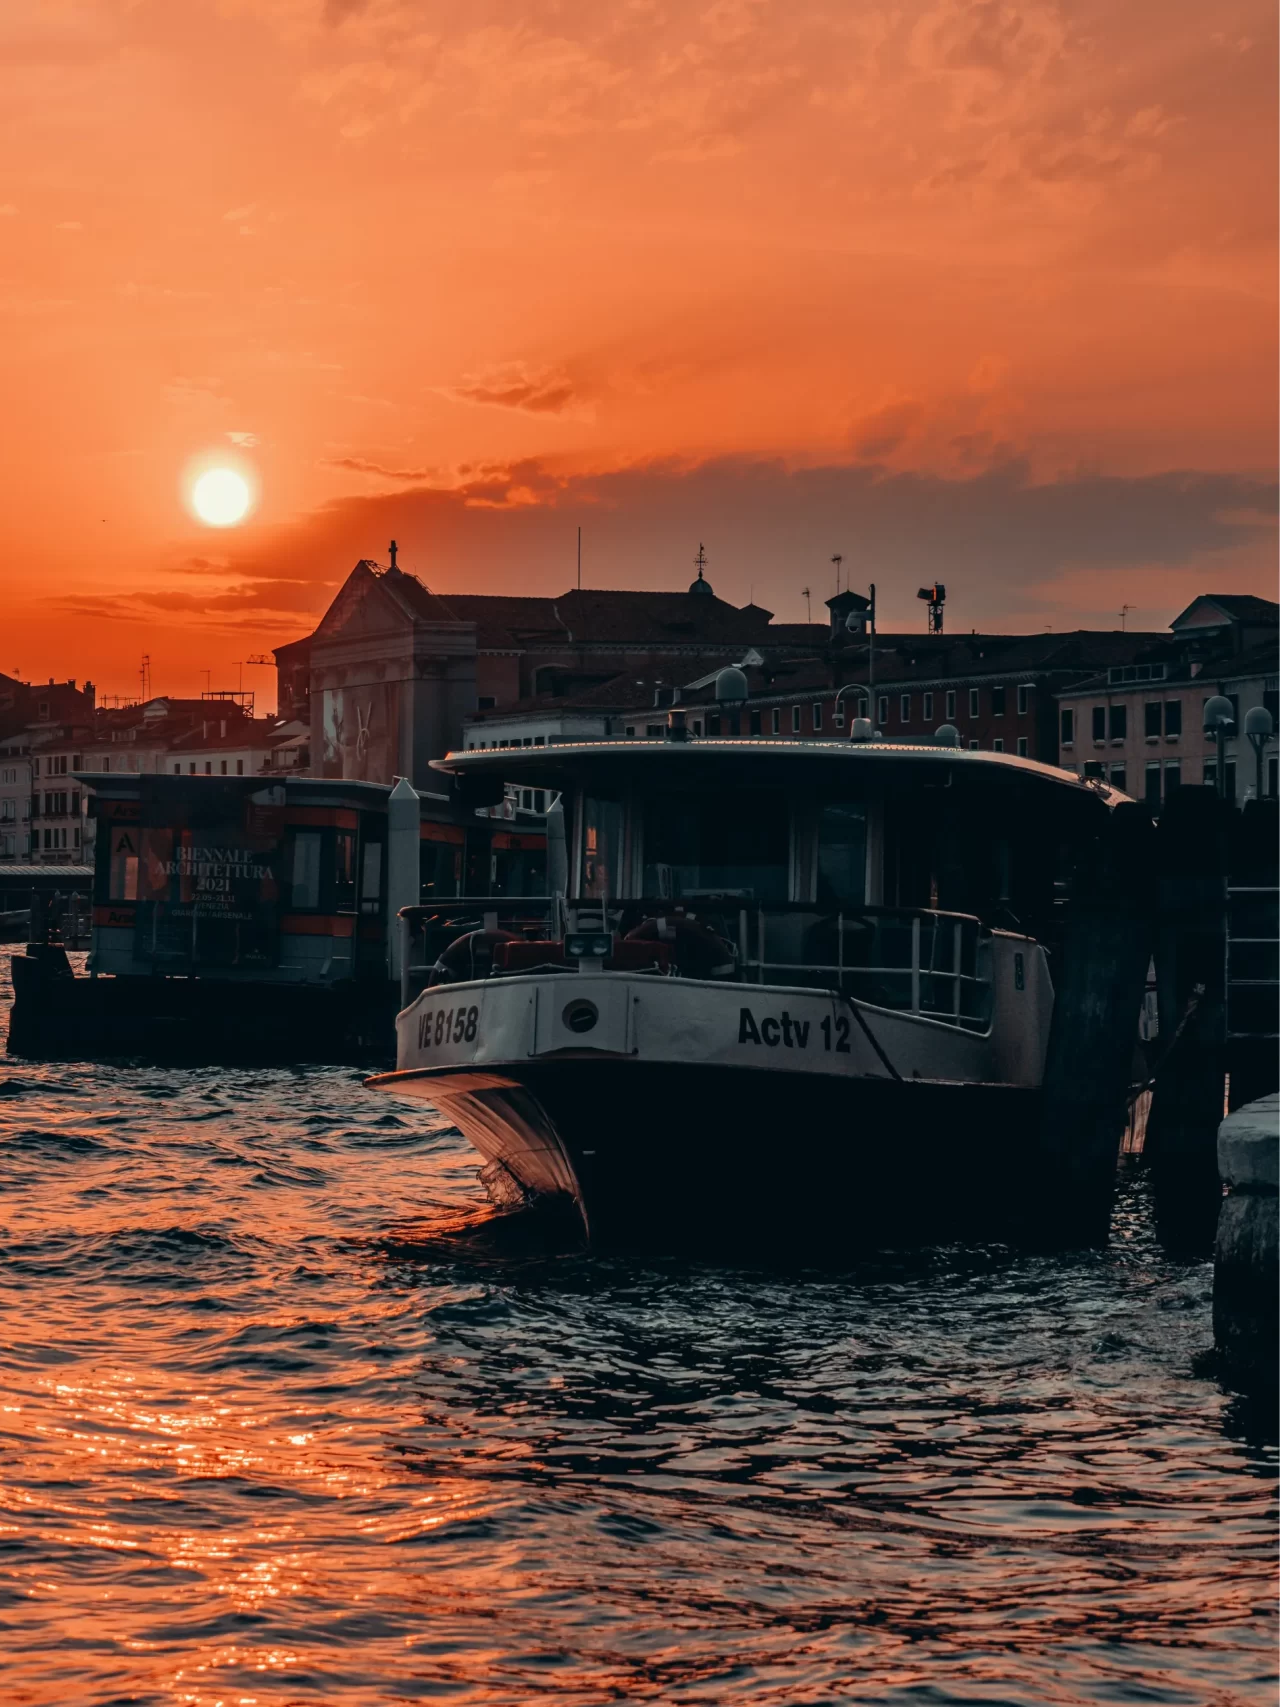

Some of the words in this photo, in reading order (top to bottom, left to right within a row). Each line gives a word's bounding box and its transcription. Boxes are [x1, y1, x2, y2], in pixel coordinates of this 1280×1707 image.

[116, 832, 136, 852] A
[176, 846, 253, 863] BIENNALE
[155, 860, 274, 880] ARCHITETTURA
[196, 877, 230, 892] 2021
[418, 1012, 433, 1049] VE
[434, 1005, 479, 1046] 8158
[738, 1007, 810, 1049] Actv
[820, 1015, 851, 1053] 12
